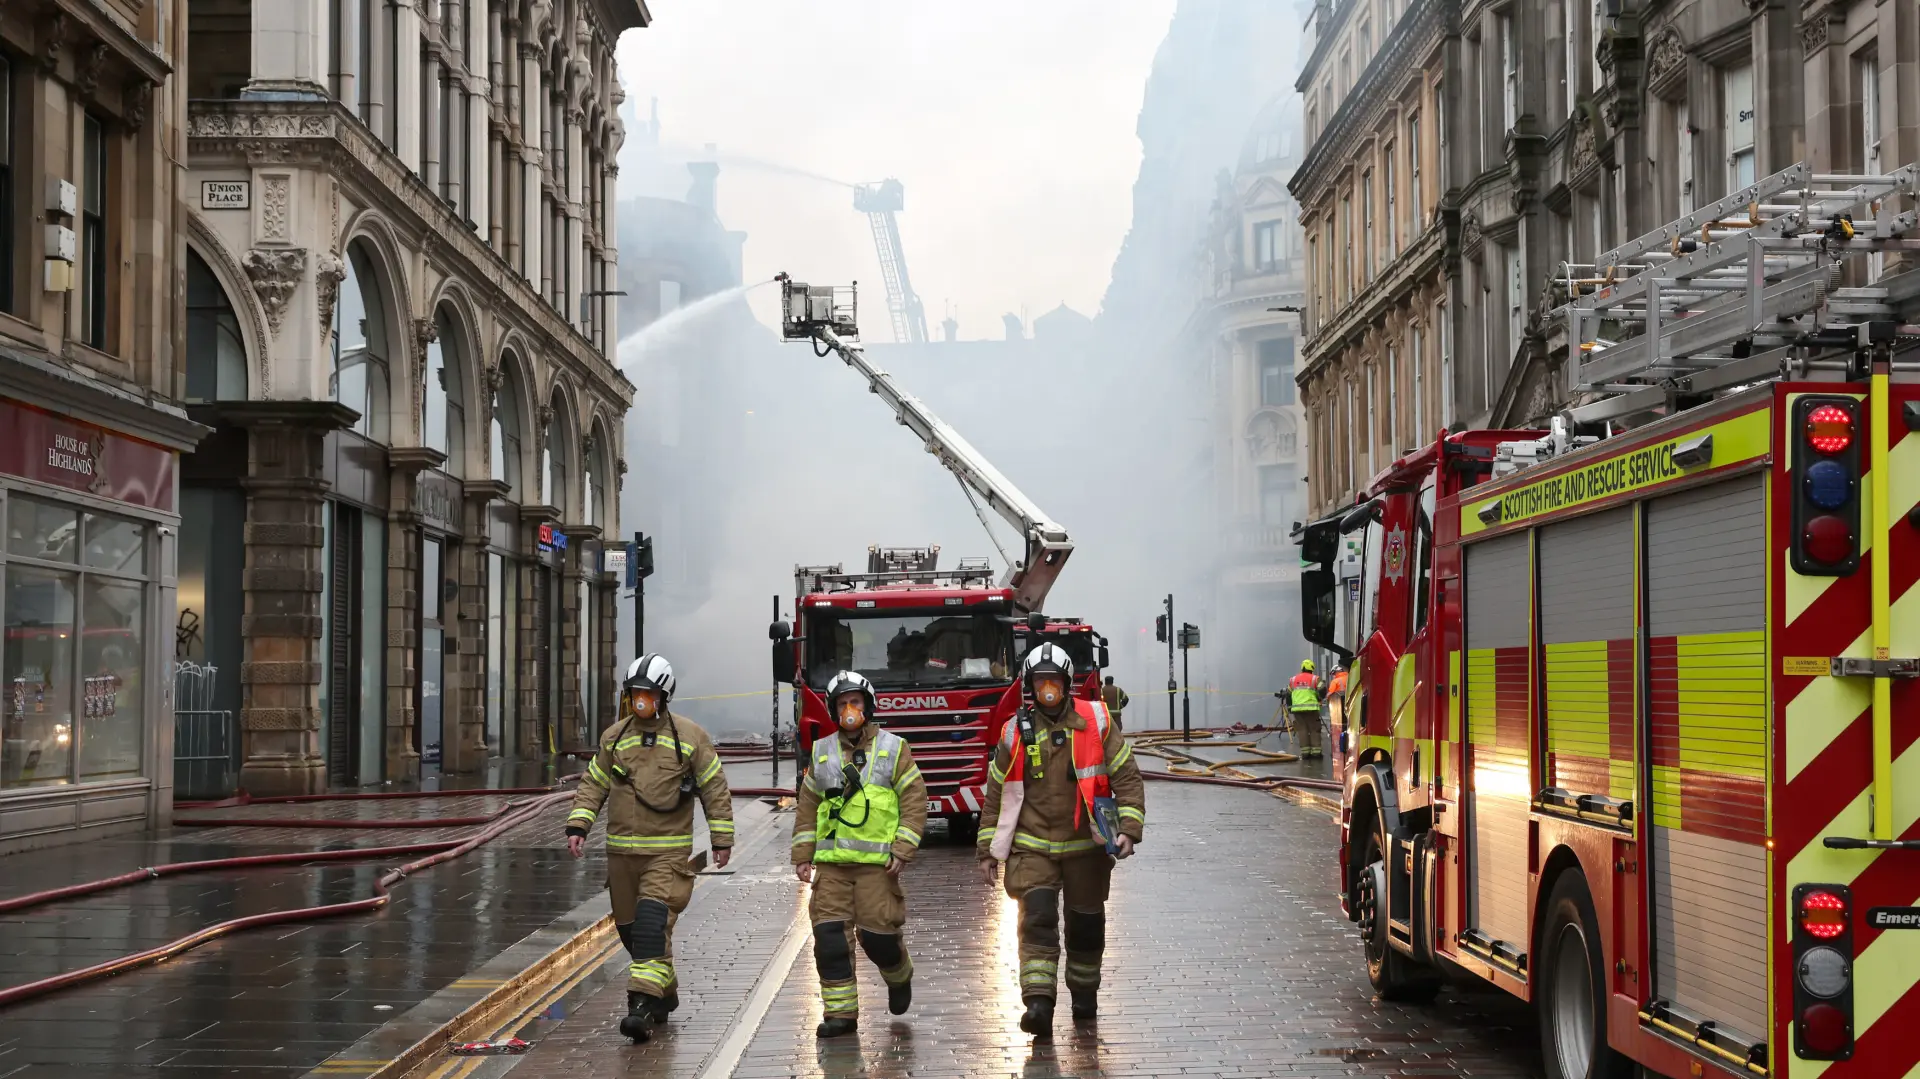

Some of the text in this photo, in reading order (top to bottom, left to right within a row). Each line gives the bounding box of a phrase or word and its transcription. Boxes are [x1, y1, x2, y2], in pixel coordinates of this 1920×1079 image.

[208, 183, 243, 193] UNION
[208, 193, 244, 202] PLACE
[55, 433, 88, 456] HOUSE OF
[48, 447, 92, 476] HIGHLANDS
[1504, 442, 1677, 521] SCOTTISH FIRE AND RESCUE SERVICE
[879, 696, 948, 710] SCANIA
